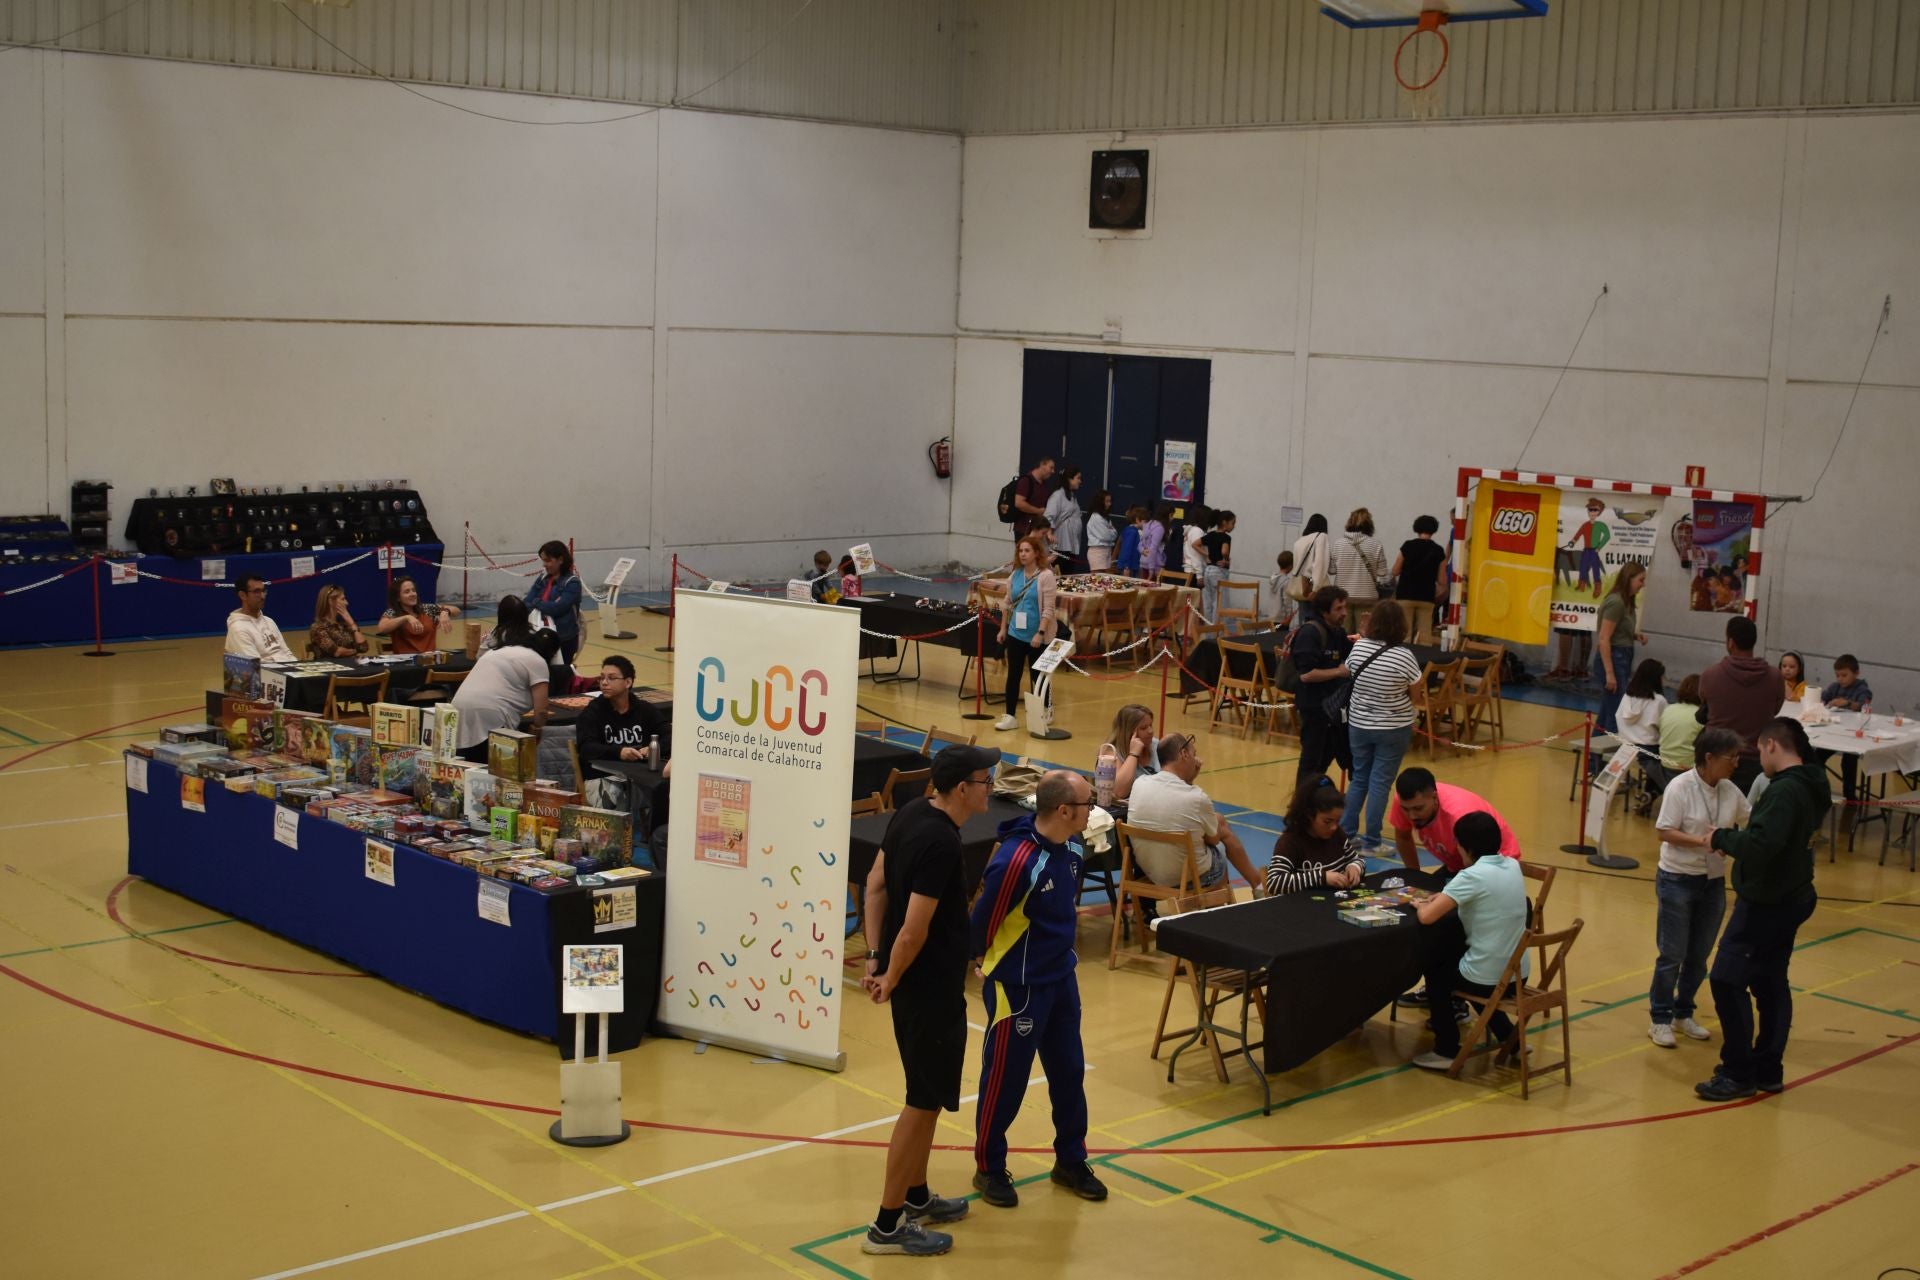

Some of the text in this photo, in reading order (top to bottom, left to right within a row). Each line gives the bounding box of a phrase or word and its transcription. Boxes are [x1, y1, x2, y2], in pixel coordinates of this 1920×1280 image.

[1493, 509, 1536, 535] LEGO
[1605, 552, 1652, 568] EL LAZARIL
[1551, 603, 1600, 614] CALAHO
[696, 656, 829, 737] CJCC
[379, 710, 403, 719] BURRITO
[604, 723, 643, 745] CJCC
[697, 726, 822, 755] Consejo de la Juventud
[697, 741, 822, 771] Comarcal de Calahorra
[438, 765, 465, 779] HEA
[527, 801, 561, 819] ANDO
[574, 814, 609, 831] ARNAK
